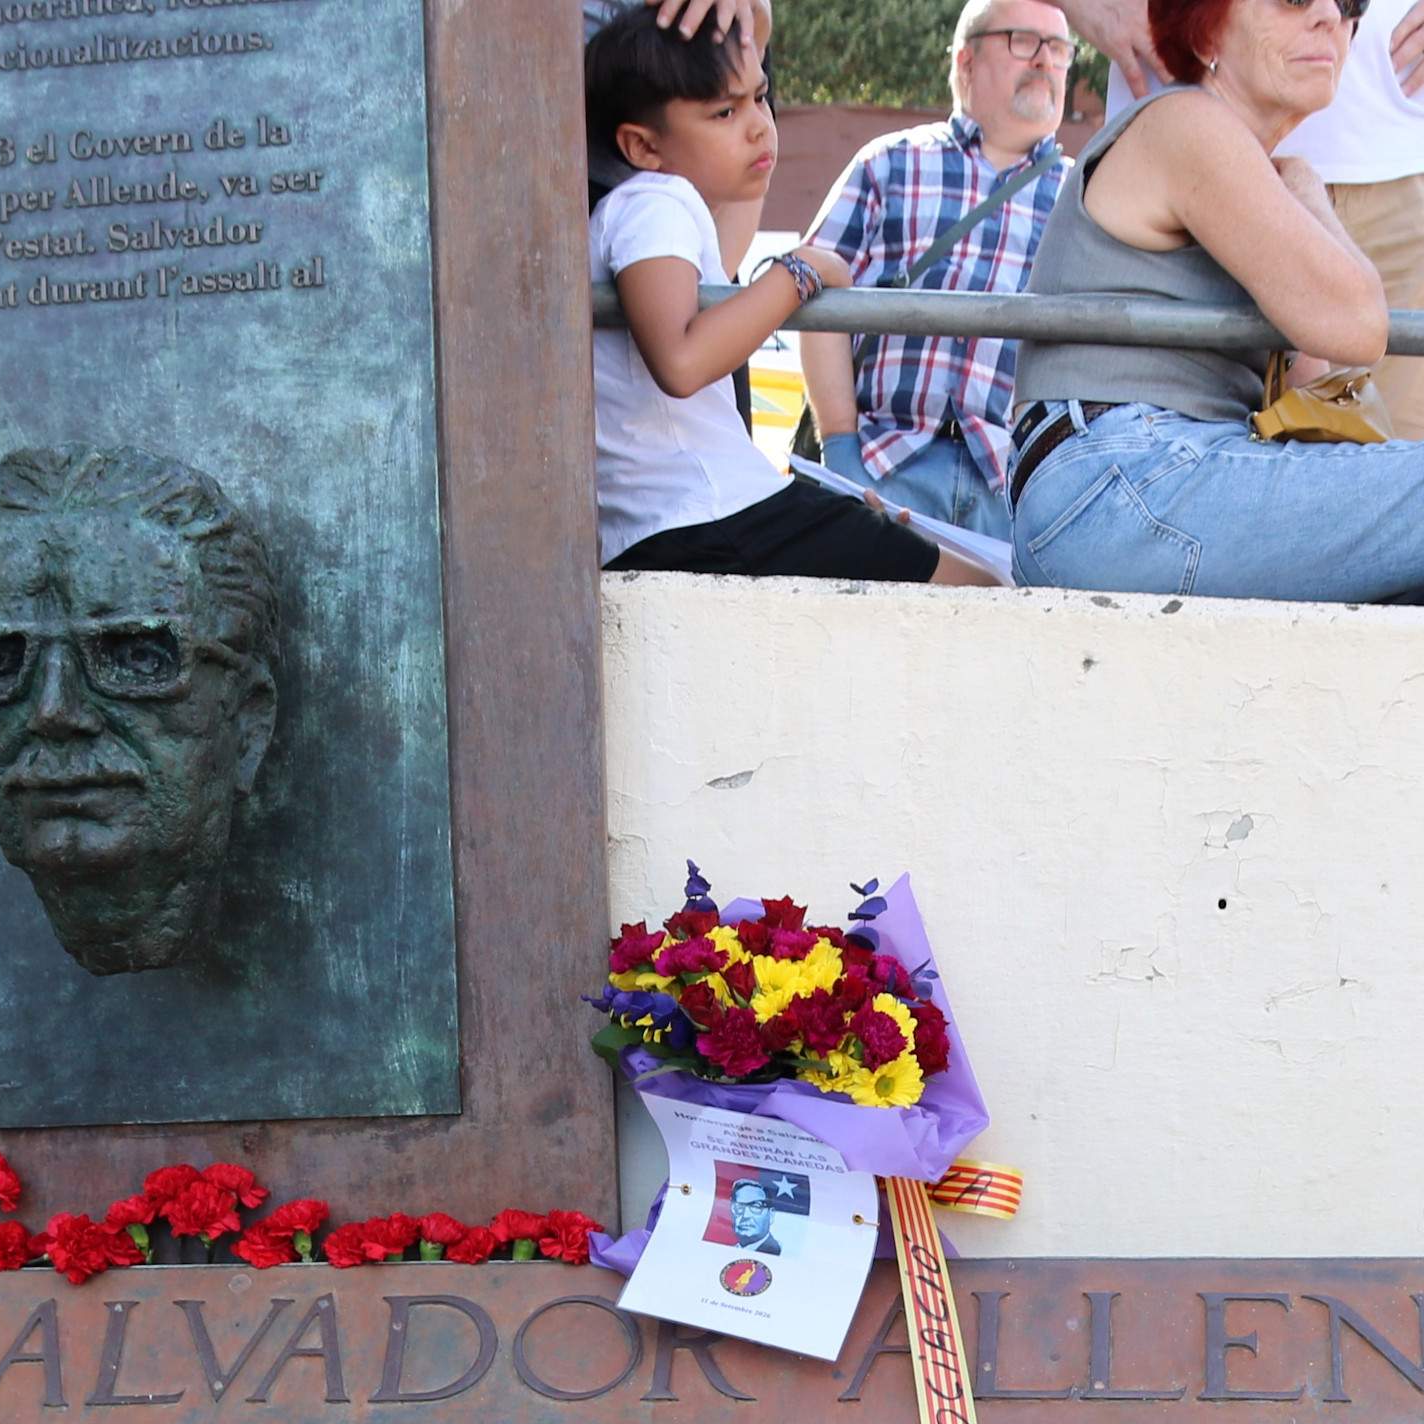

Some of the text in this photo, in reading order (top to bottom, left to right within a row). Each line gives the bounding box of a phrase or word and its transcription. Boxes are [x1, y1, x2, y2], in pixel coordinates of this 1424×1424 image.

[25, 132, 57, 164] el
[69, 128, 192, 161] Govern
[204, 118, 246, 151] de
[257, 114, 292, 147] la
[64, 171, 209, 209] Allende,
[219, 171, 259, 198] va
[270, 166, 324, 194] ser
[107, 214, 264, 254] Salvador
[27, 271, 146, 308] durant
[156, 260, 281, 297] l'assalt
[290, 255, 326, 290] al
[690, 1140, 845, 1174] GRANDES ALAMEDAS
